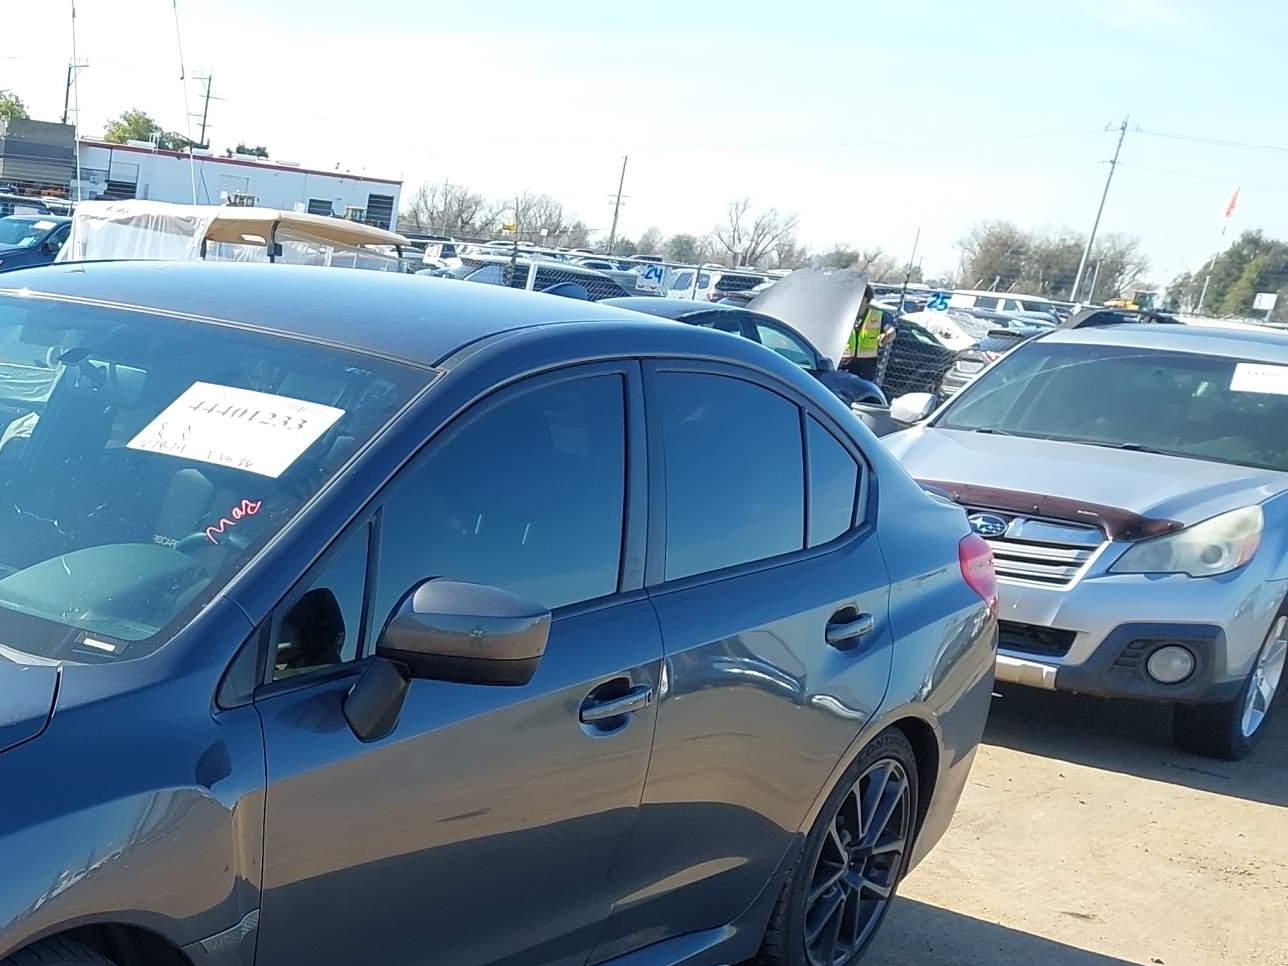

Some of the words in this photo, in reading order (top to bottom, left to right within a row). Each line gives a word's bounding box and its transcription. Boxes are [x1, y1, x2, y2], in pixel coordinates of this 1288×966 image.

[643, 264, 663, 284] 24
[927, 292, 952, 311] 25
[188, 401, 308, 431] 44401233
